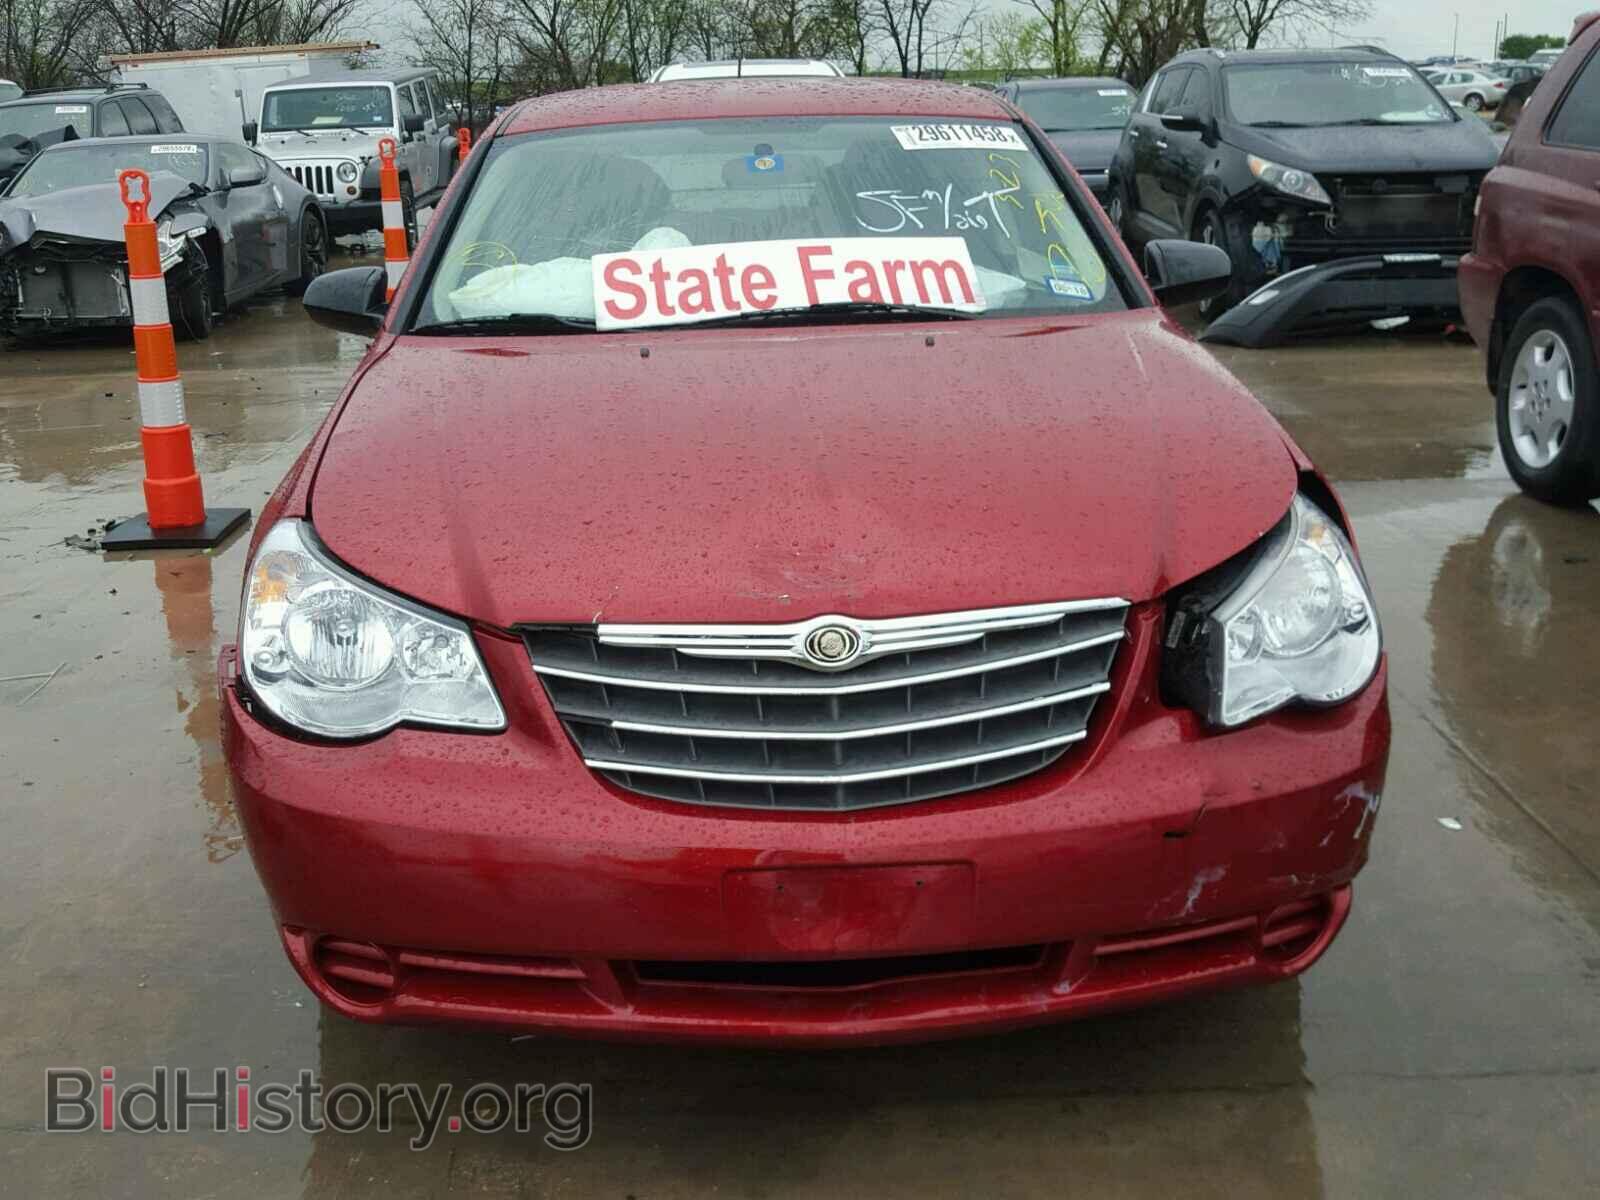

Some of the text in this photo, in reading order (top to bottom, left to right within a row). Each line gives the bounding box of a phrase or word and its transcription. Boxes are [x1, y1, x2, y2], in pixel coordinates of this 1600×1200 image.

[911, 125, 1008, 142] 29611458
[603, 254, 778, 321] State
[797, 245, 976, 306] Farm
